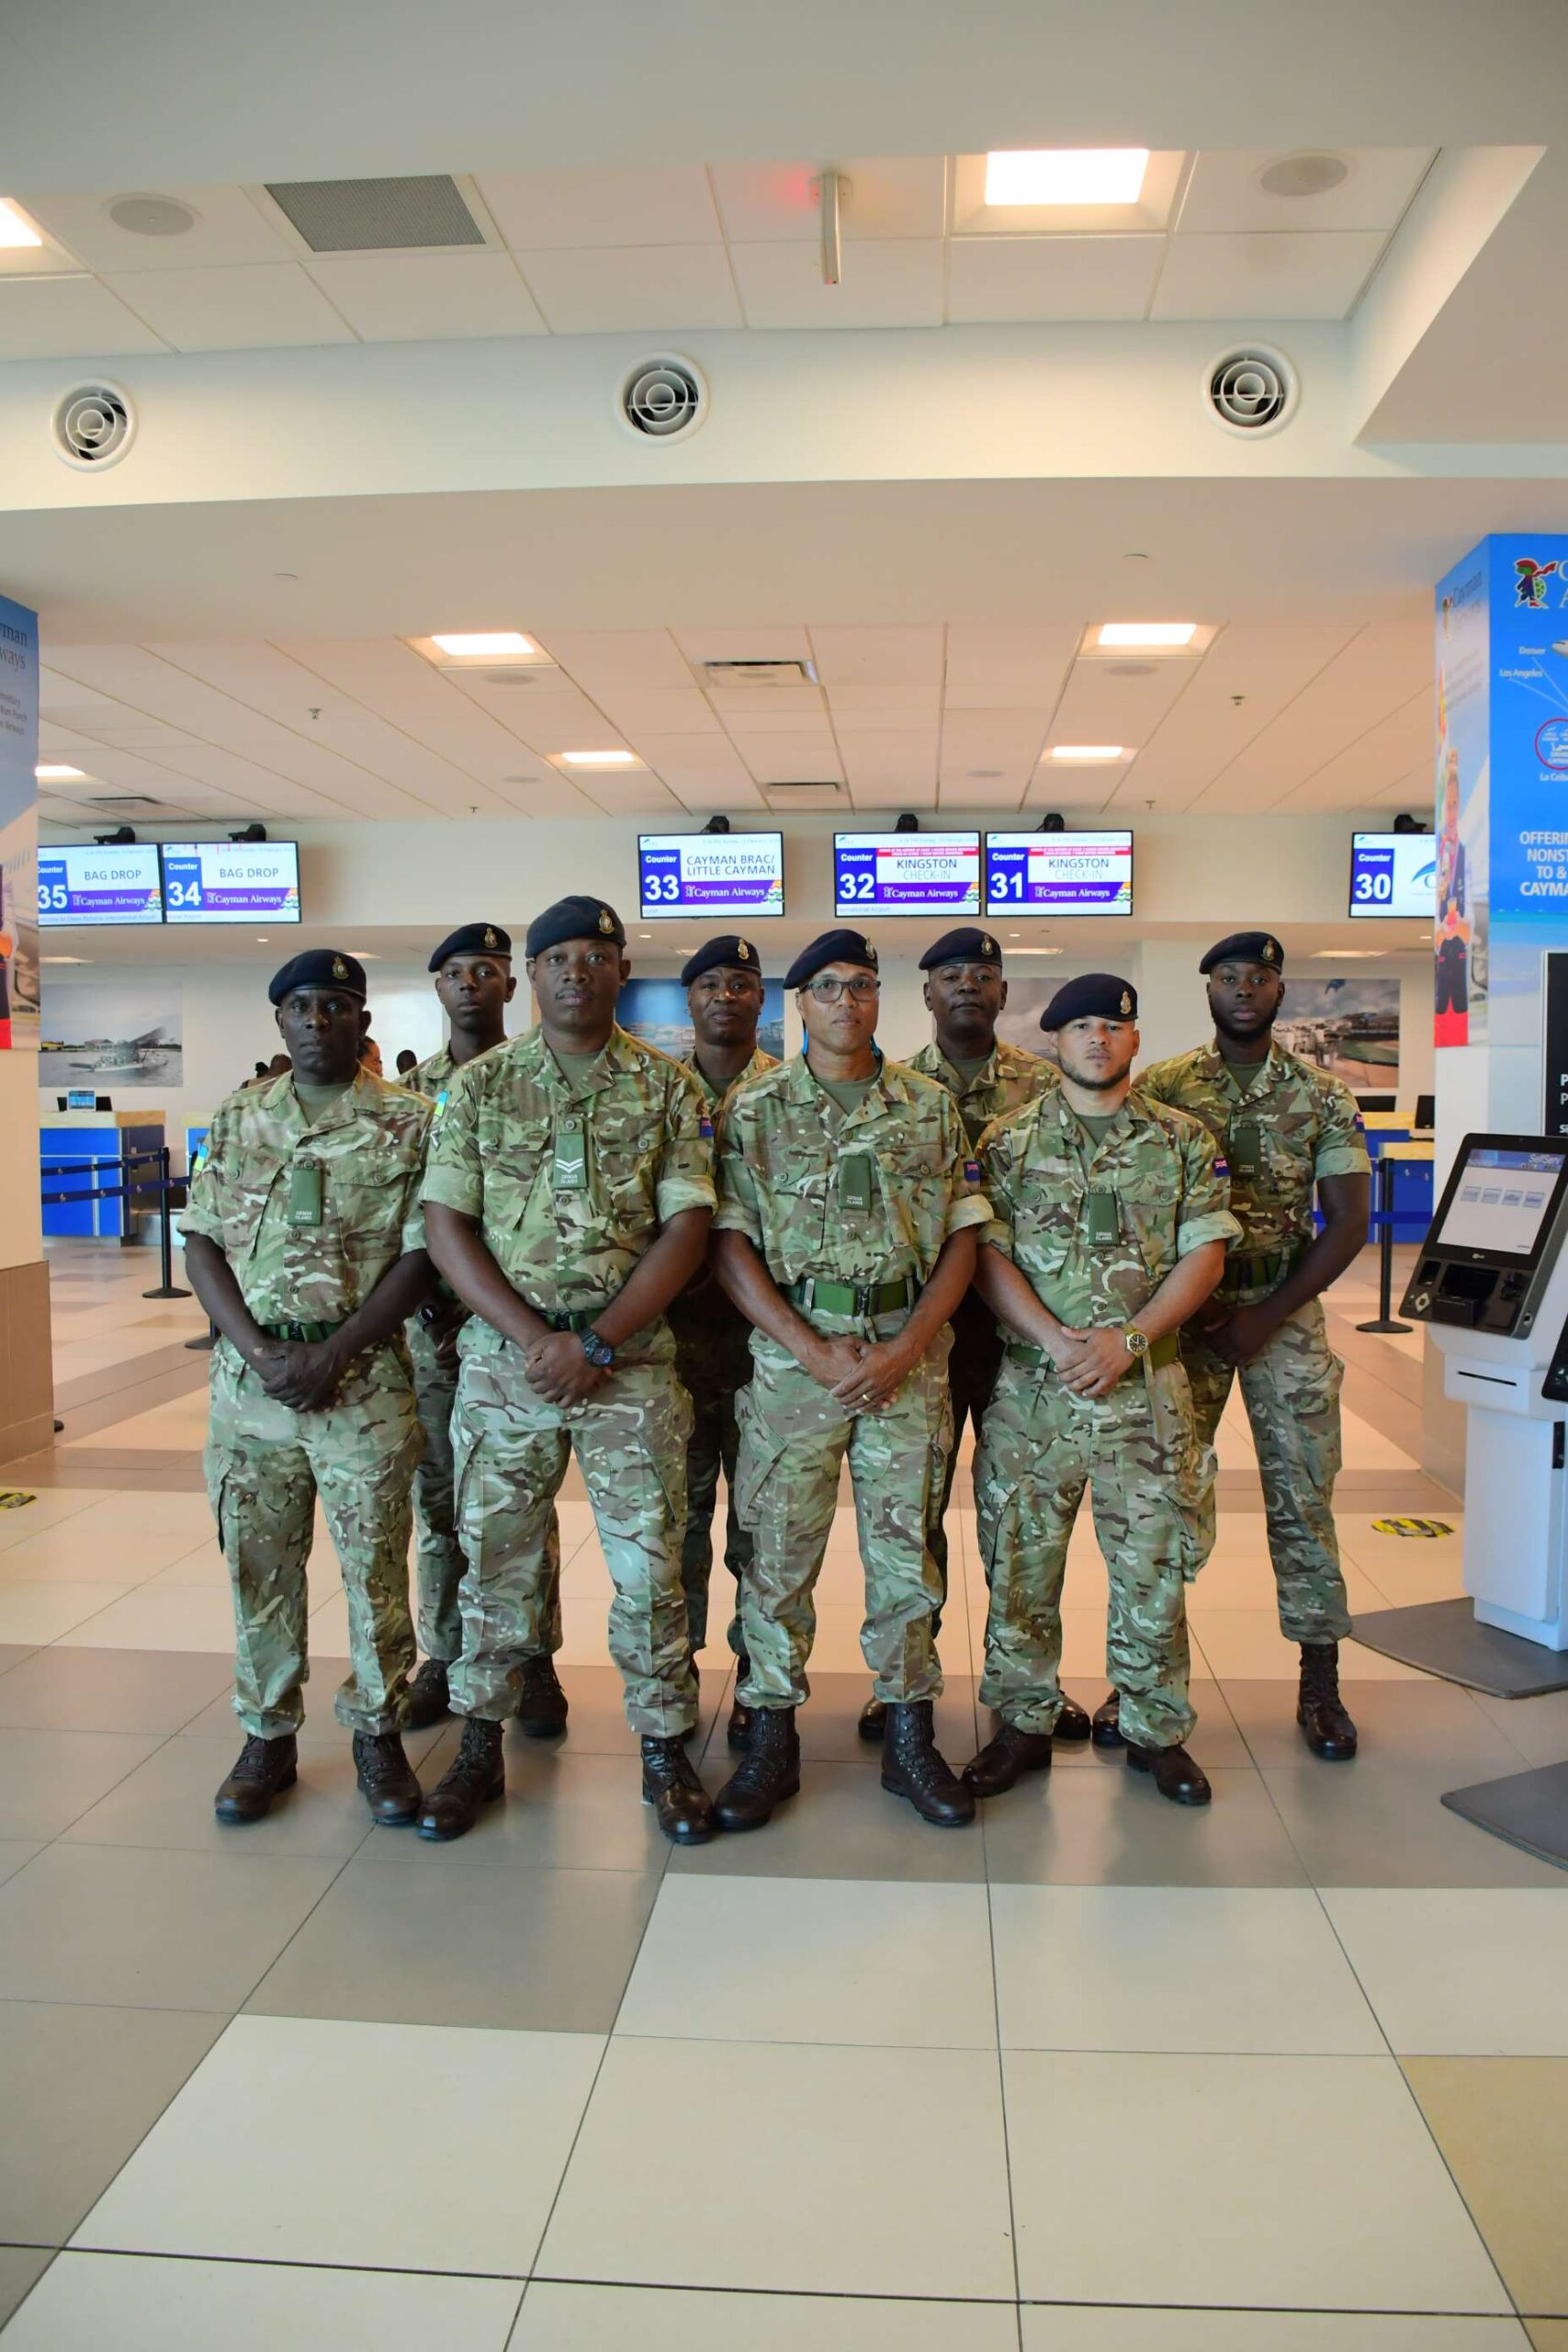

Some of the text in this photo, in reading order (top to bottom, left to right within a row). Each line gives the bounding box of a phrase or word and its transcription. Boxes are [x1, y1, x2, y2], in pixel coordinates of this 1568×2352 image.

[0, 623, 28, 648] man
[645, 855, 677, 864] Counter
[687, 854, 775, 865] CAYMAN BRAC/
[840, 854, 873, 862] Counter
[992, 853, 1025, 861] Counter
[1358, 854, 1392, 862] Counter
[1527, 848, 1568, 863] NONS
[168, 863, 198, 871] Counter
[897, 858, 957, 869] KINGSTON
[1048, 858, 1110, 868] KINGSTON
[85, 870, 141, 880] BAG DROP
[220, 868, 279, 877] BAG DROP
[687, 865, 775, 876] LITTLE CAYMAN
[903, 870, 951, 880] CHECK-IN
[1055, 869, 1103, 879] CHECK-IN
[1536, 865, 1567, 879] TO &
[645, 875, 680, 900] 33
[840, 873, 874, 899] 32
[990, 872, 1022, 899] 31
[1355, 873, 1392, 899] 30
[39, 885, 68, 910] 35
[168, 881, 201, 906] 34
[694, 888, 764, 899] Cayman Airways
[892, 888, 958, 899] Cayman Airways
[1043, 888, 1110, 899] Cayman Airways
[80, 896, 145, 908] Cayman Airways
[215, 895, 282, 905] Cayman Airways
[1561, 1073, 1568, 1086] P
[1561, 1092, 1568, 1105] P
